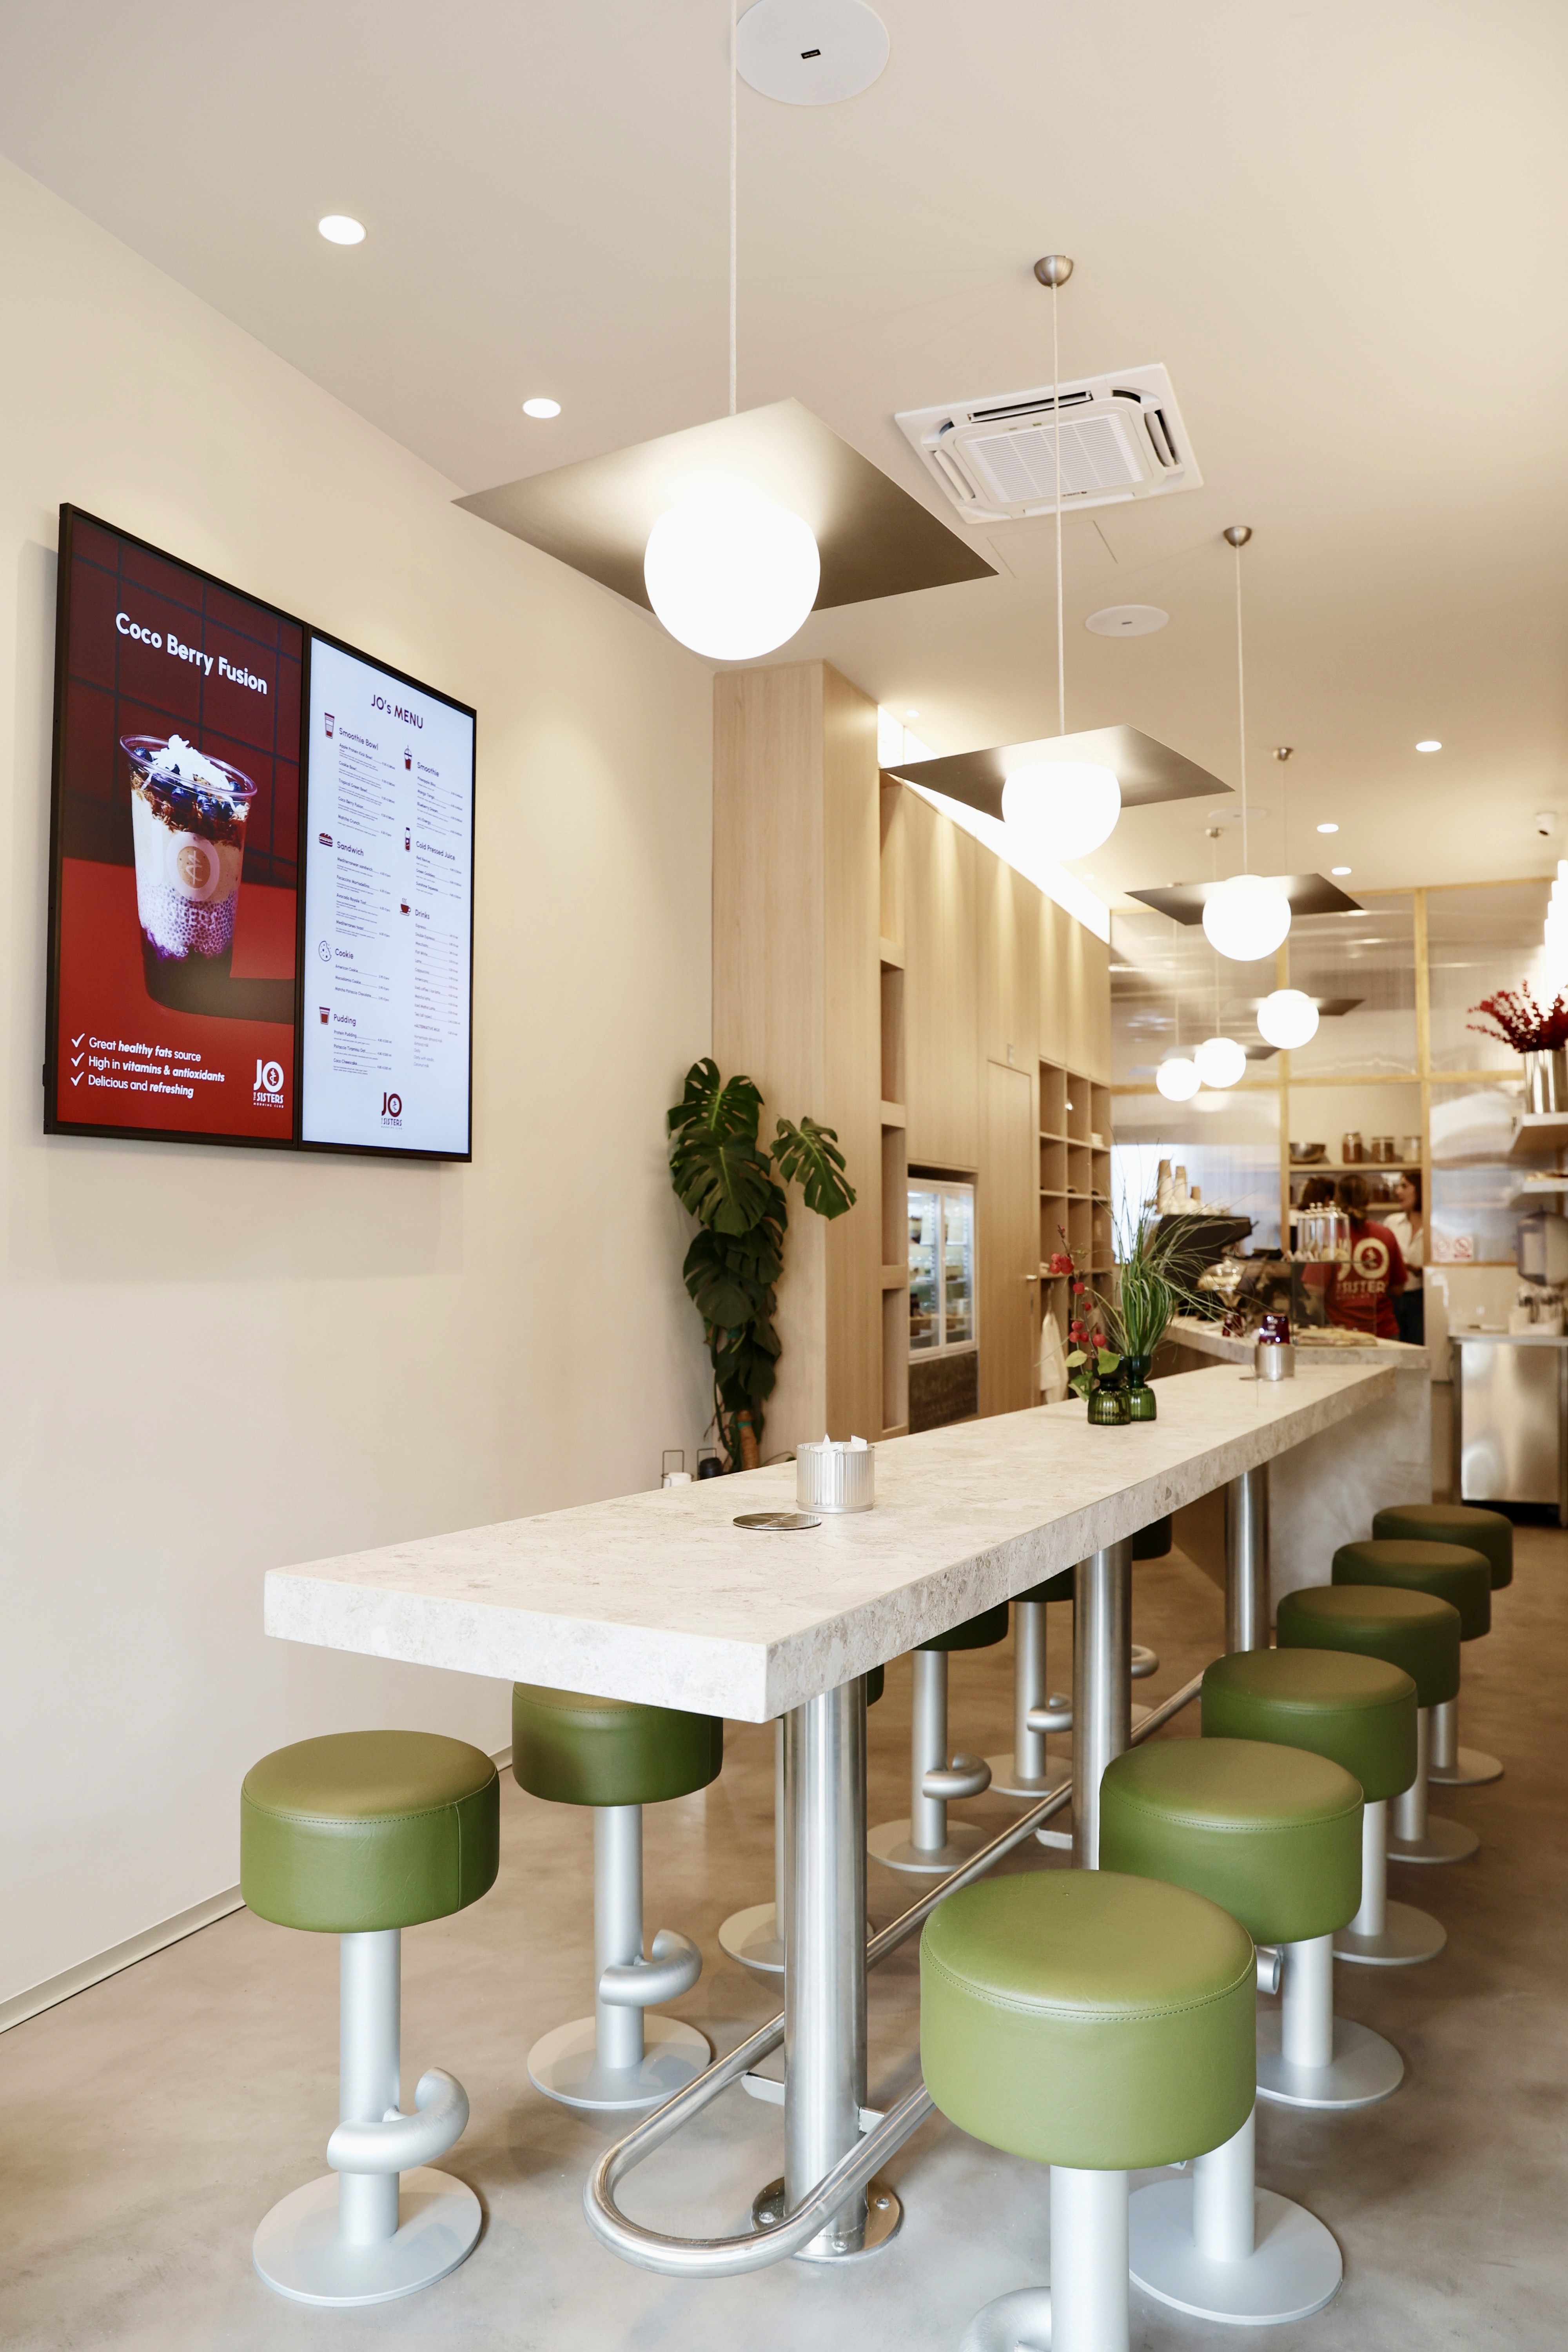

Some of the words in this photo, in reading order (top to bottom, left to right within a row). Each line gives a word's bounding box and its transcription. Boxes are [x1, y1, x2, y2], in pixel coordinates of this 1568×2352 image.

[116, 613, 162, 648] Coco
[167, 633, 214, 676] Berry
[218, 656, 267, 695] Fusion
[371, 694, 391, 714] JO's
[394, 705, 423, 729] MENU
[339, 728, 364, 744] Smoothie
[366, 739, 378, 750] Bowl
[417, 762, 439, 777] Smoothie
[337, 841, 363, 856] Sandwich
[416, 841, 426, 850] Cold
[427, 845, 443, 856] Pressed
[445, 852, 455, 860] Juice
[415, 909, 430, 919] Drinks
[335, 948, 353, 959] Cookie
[334, 1014, 356, 1027] Pudding
[89, 1037, 116, 1051] Great
[118, 1040, 153, 1058] healthy
[155, 1045, 172, 1058] fats
[174, 1051, 201, 1062] source
[89, 1055, 110, 1071] High
[112, 1059, 120, 1069] in
[122, 1061, 162, 1075] vitamins
[163, 1065, 171, 1076] &
[172, 1067, 225, 1082] antioxidants
[253, 1059, 284, 1093] JO
[88, 1074, 128, 1089] Delicious
[130, 1080, 148, 1091] and
[149, 1082, 194, 1099] refreshing
[257, 1092, 284, 1104] SISTERS
[381, 1092, 402, 1117] JO
[383, 1118, 402, 1126] SISTERS
